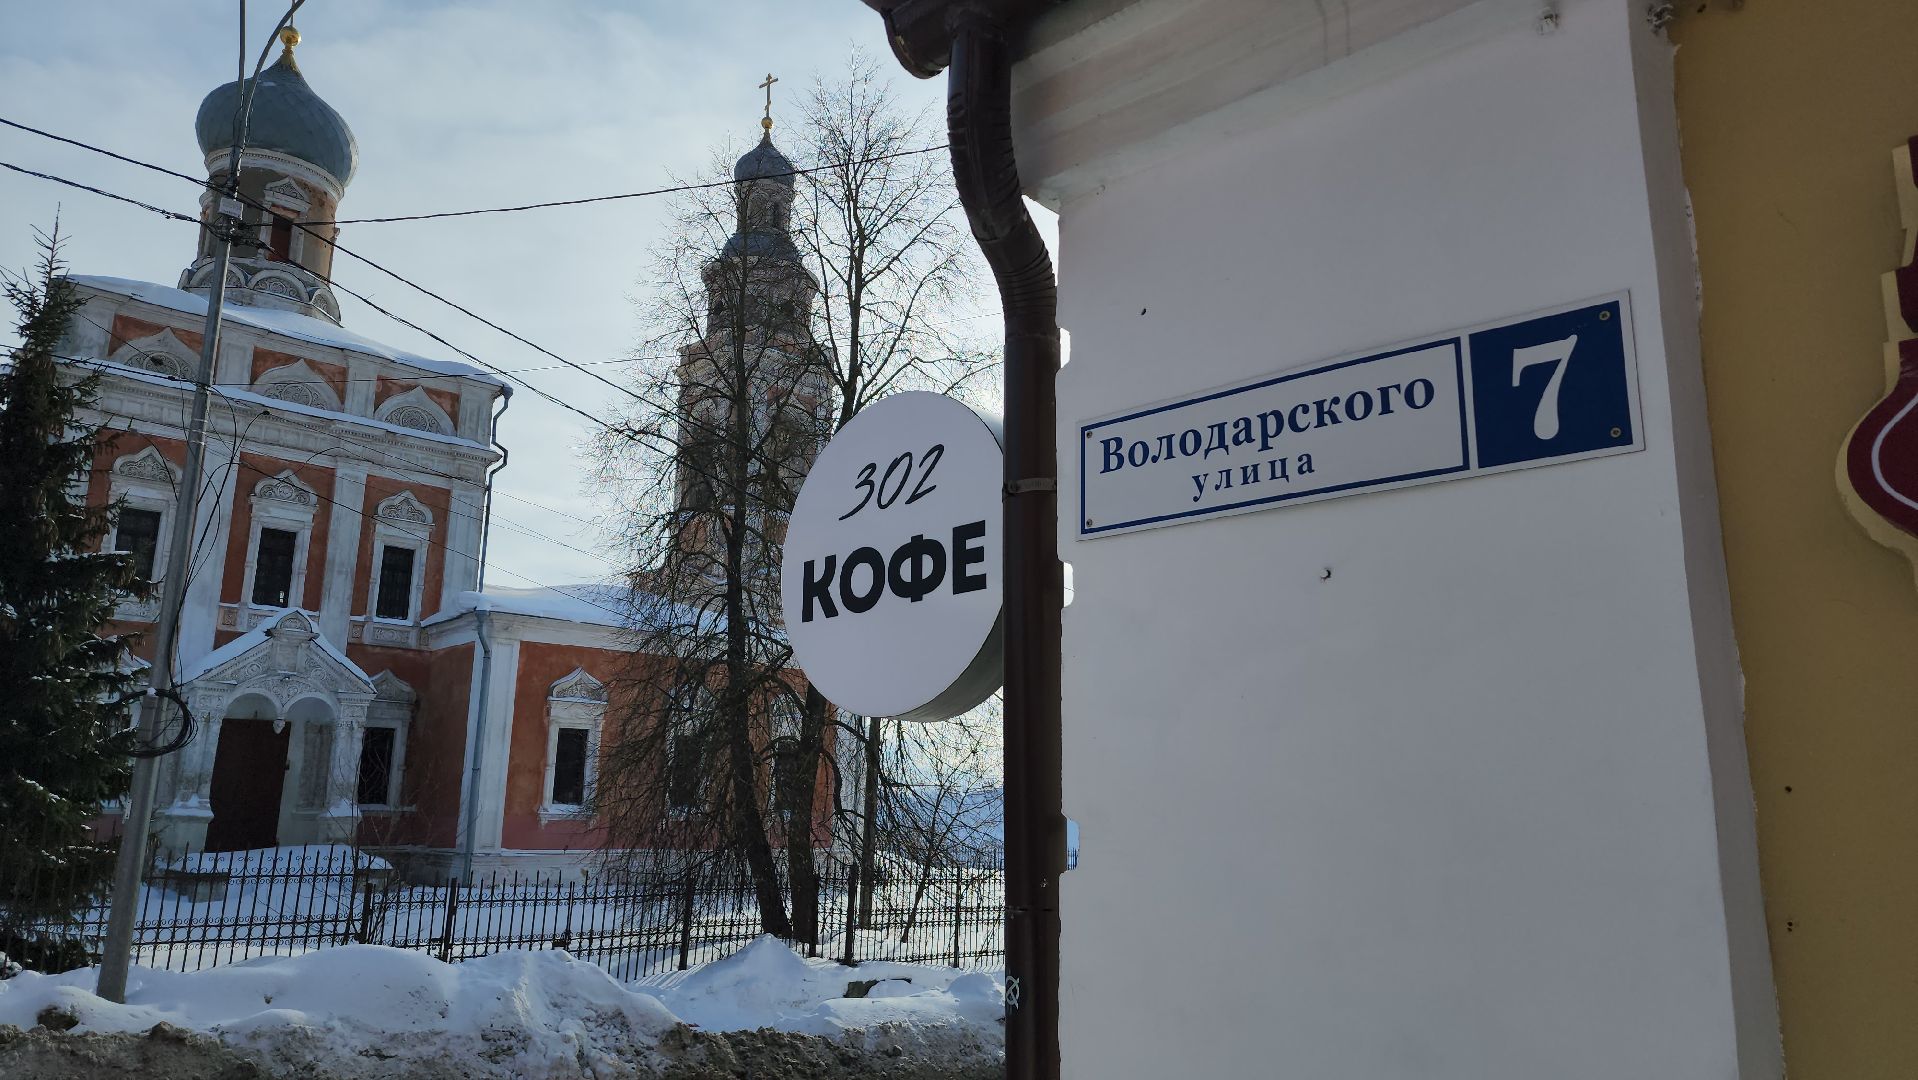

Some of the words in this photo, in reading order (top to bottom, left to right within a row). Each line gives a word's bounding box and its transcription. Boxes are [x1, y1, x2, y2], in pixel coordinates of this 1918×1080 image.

[1099, 377, 1435, 475] Володарского
[1511, 334, 1578, 441] 7
[838, 443, 945, 521] 302
[1191, 453, 1316, 503] улица
[801, 519, 987, 623] КОФЕ
